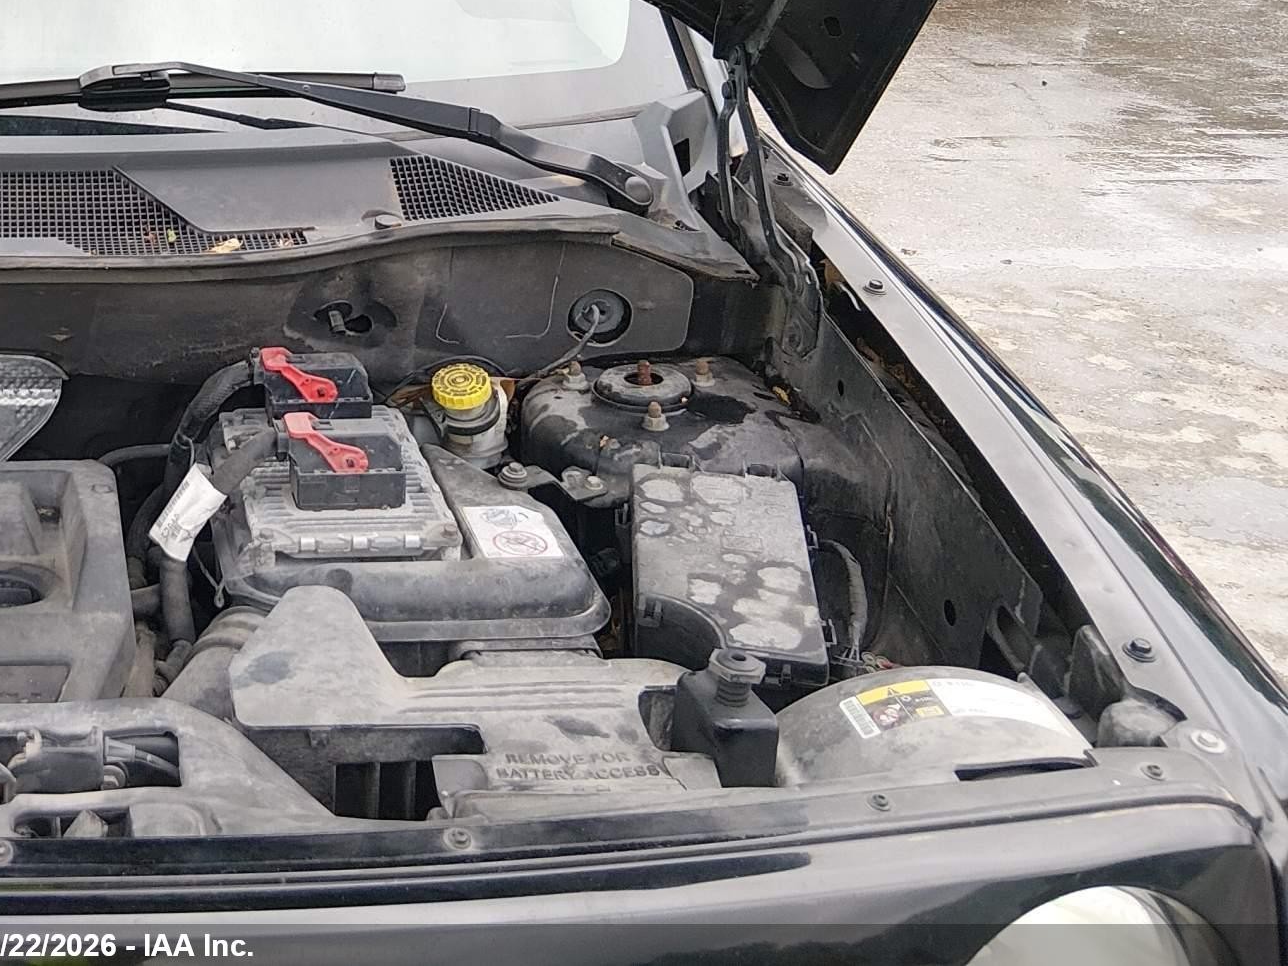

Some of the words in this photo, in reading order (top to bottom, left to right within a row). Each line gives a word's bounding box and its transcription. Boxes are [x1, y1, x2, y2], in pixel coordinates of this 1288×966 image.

[505, 753, 585, 765] REMOVE
[591, 753, 631, 763] FOR
[496, 767, 578, 780] BATTERY
